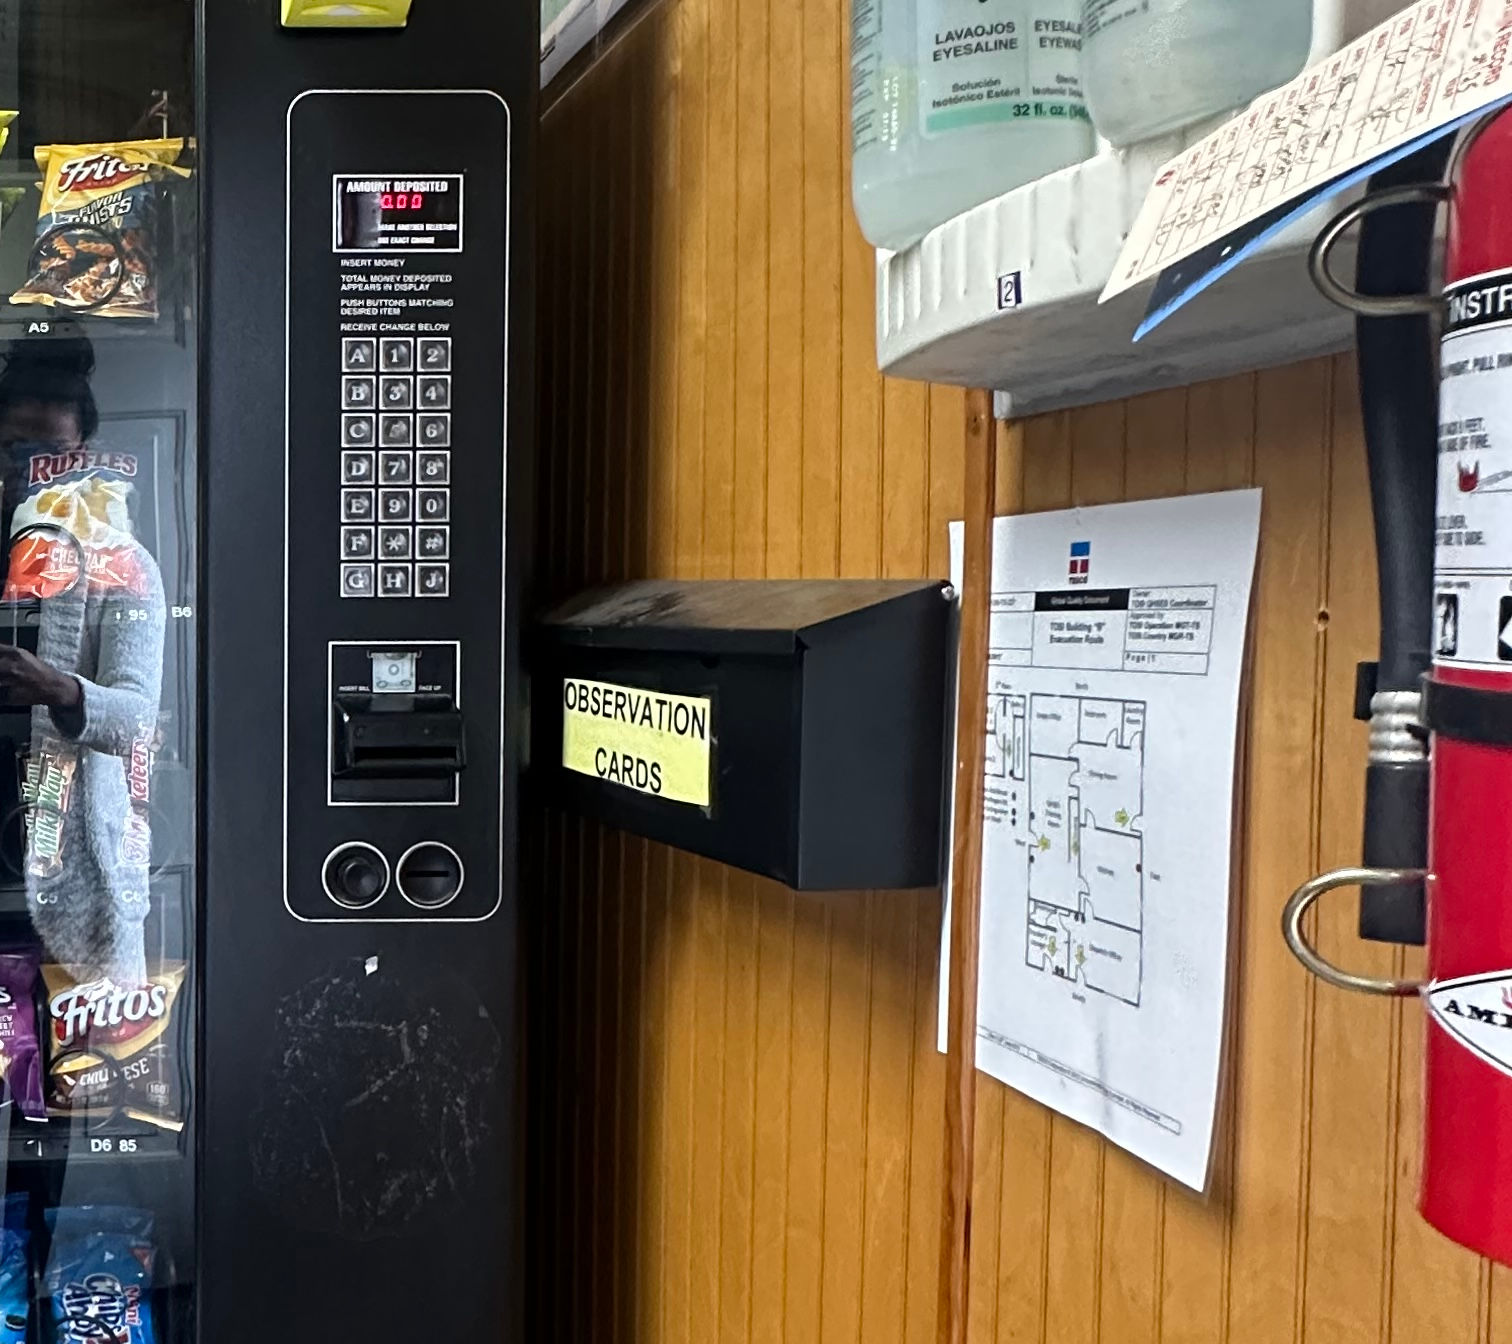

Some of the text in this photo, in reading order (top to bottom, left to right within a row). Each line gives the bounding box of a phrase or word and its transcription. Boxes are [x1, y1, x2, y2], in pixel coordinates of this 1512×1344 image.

[935, 22, 1015, 45] LAVAOJOS
[933, 38, 1018, 62] EYESALINE
[952, 79, 1001, 92] Solución
[933, 88, 1020, 108] Isotónico Estéril
[1012, 104, 1066, 116] 32 fl. oz.
[347, 181, 448, 192] AMOUNT DEPOSITED
[79, 192, 123, 218] FLAVOR
[340, 259, 405, 267] INSERT MONEY
[340, 275, 452, 283] TOTAL MONEY DEPOSITED
[340, 283, 430, 291] APPEARS IN DISPLAY
[1003, 280, 1014, 302] 2
[340, 299, 453, 307] PUSH BUTTONS MATCHING
[340, 307, 401, 315] DESIRED ITEM
[28, 322, 50, 333] A5
[340, 323, 450, 331] RECEIVE CHANGE BELOW
[349, 348, 439, 363] A 1 2
[351, 385, 437, 401] B 3 4
[349, 423, 437, 438] C 6
[29, 450, 138, 488] RUFFLES
[351, 460, 438, 476] D 7 8
[350, 498, 365, 513] E
[389, 498, 400, 513] 9
[351, 536, 364, 551] F
[348, 572, 437, 588] G H J
[171, 607, 192, 618] B6
[565, 682, 706, 740] OBSERVATION
[595, 747, 662, 794] CARDS
[39, 764, 69, 810] Way
[50, 980, 167, 1047] Fritos
[79, 1068, 109, 1086] CHILI
[90, 1139, 137, 1152] D6 85
